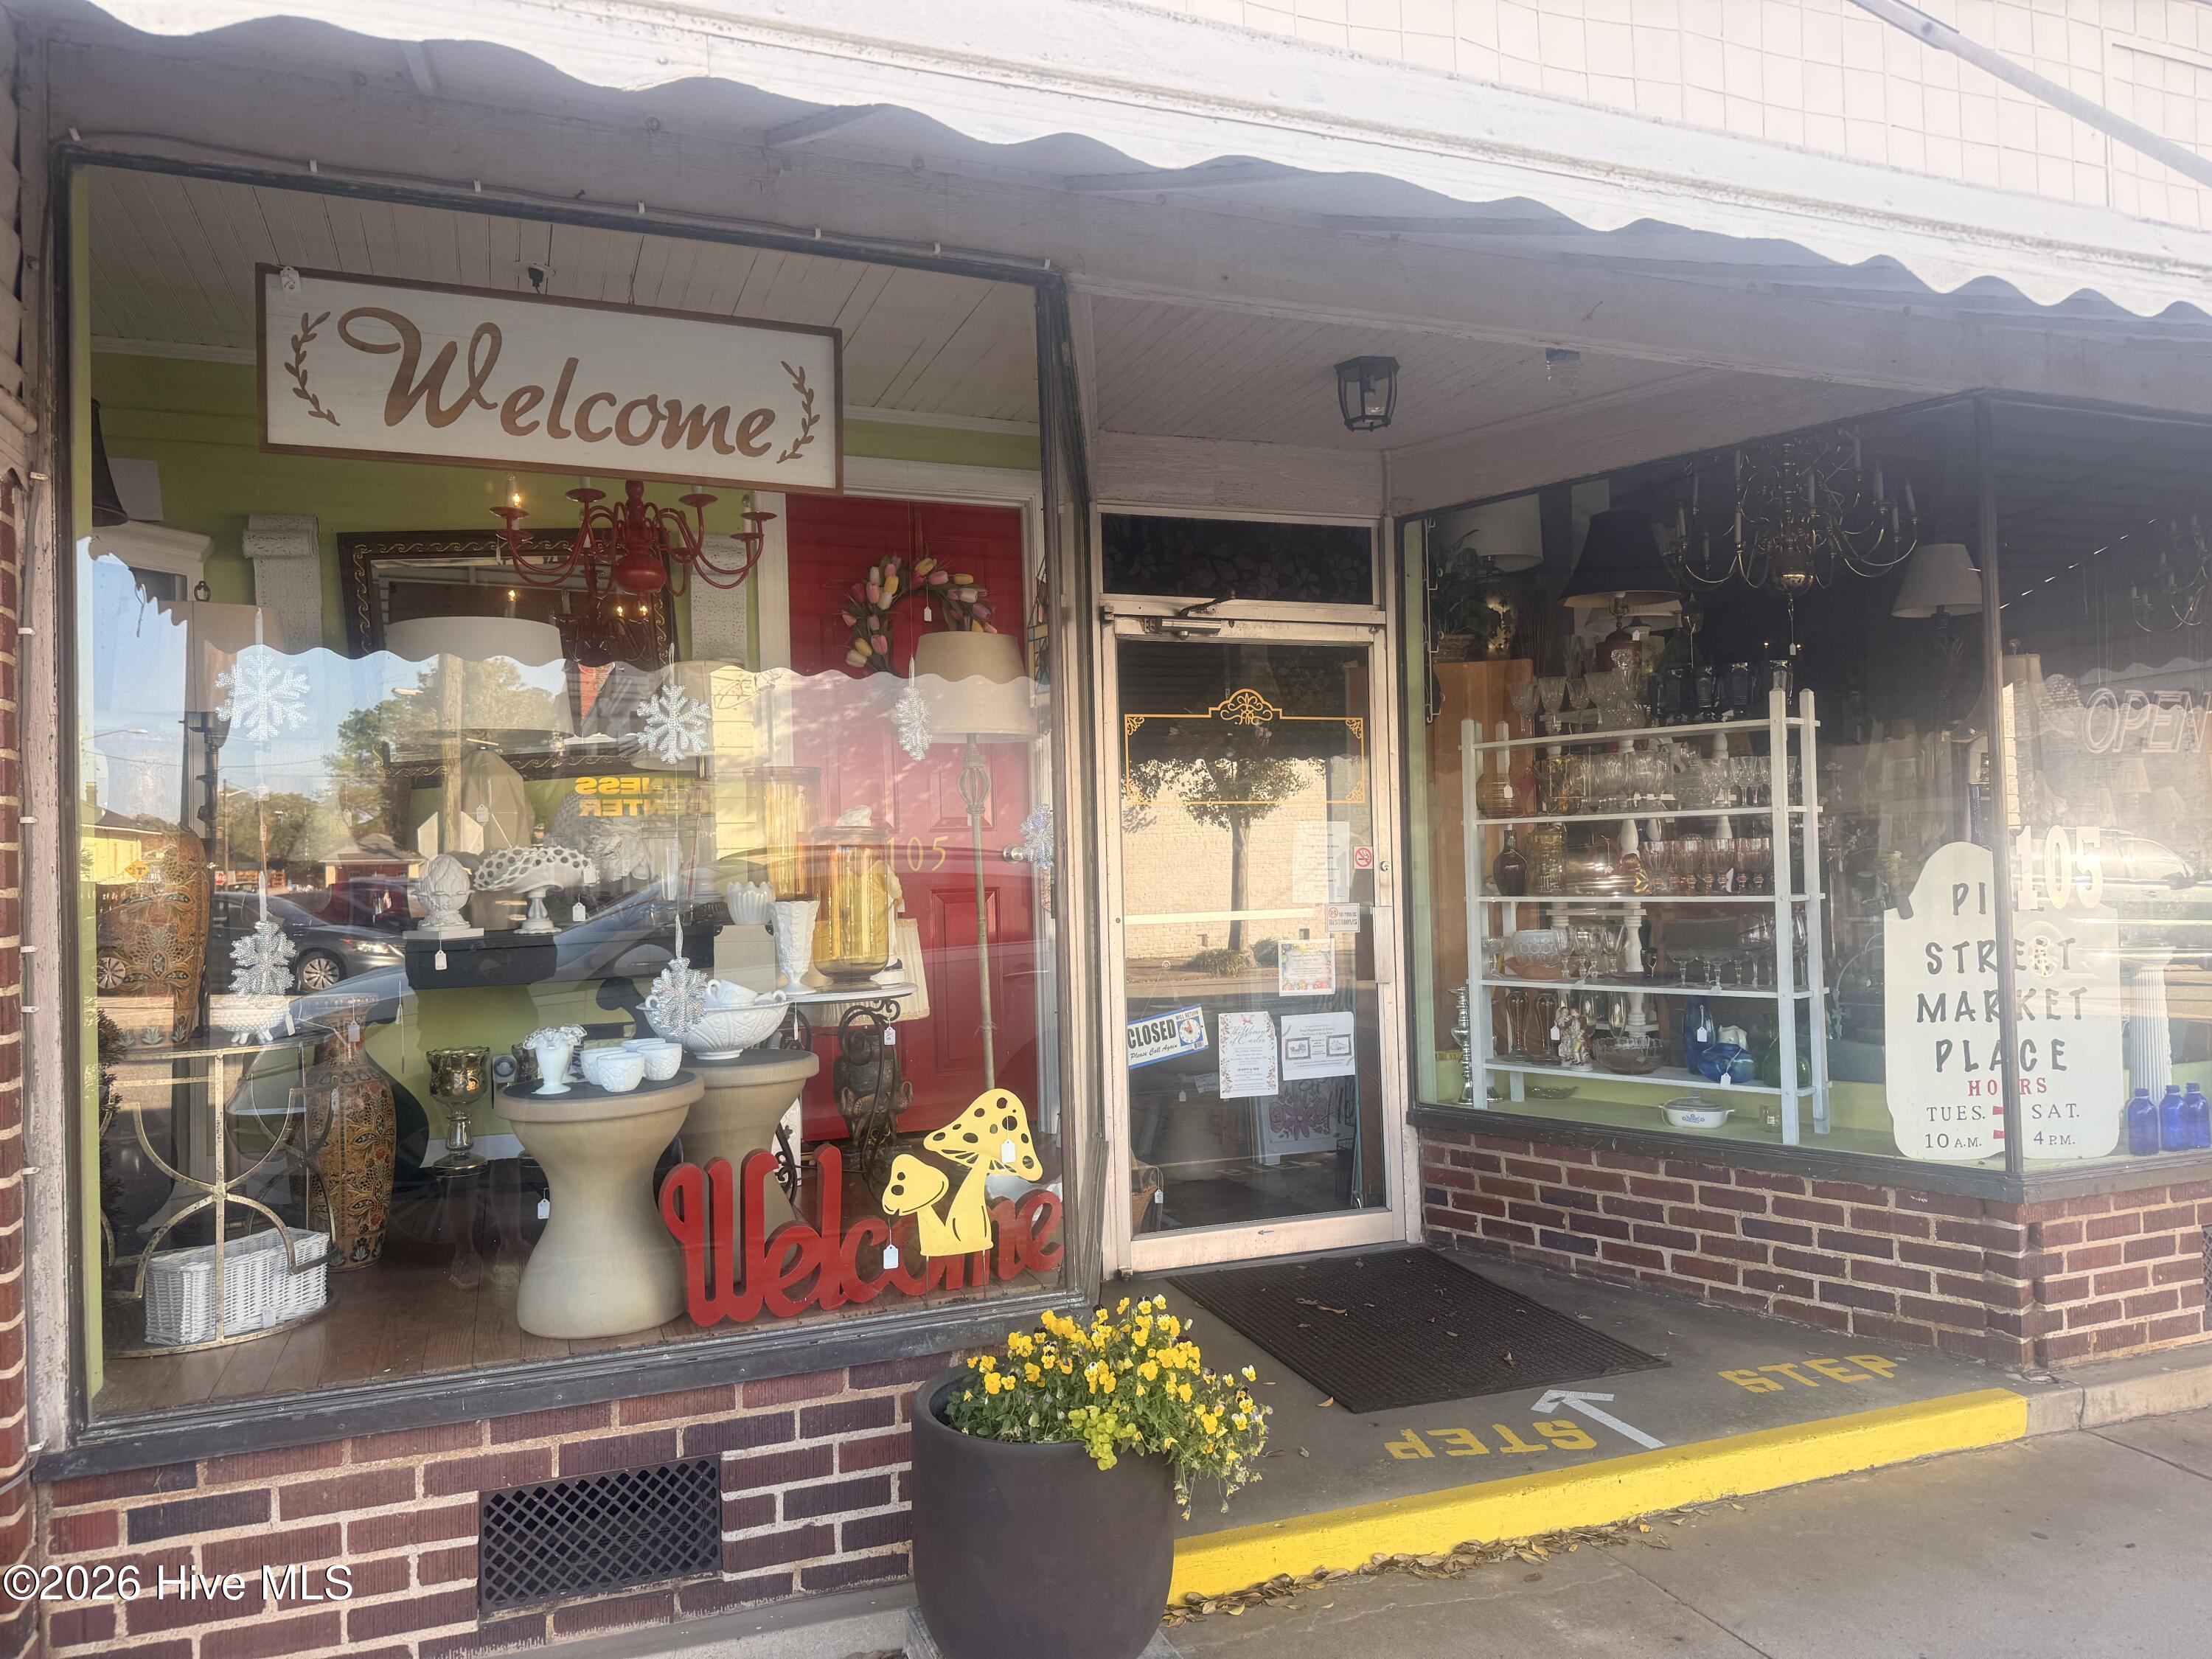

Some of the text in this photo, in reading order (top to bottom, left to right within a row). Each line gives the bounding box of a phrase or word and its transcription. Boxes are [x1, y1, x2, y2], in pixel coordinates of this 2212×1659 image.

[337, 307, 777, 457] Welcome
[2082, 687, 2212, 754] OPEN
[886, 836, 948, 872] 105
[2015, 824, 2102, 909] 105
[1185, 1010, 1199, 1018] RETURN
[1916, 987, 2087, 1023] MARKET
[1127, 1018, 1177, 1049] CLOSED
[1130, 1043, 1178, 1060] Please Call Again
[1967, 1077, 2047, 1096] HORS
[1926, 1103, 2079, 1121] TUES. SAT.
[1924, 1133, 1949, 1148] 10
[2033, 1130, 2044, 1145] 4
[1717, 1354, 1899, 1393] STEP
[1383, 1419, 1597, 1459] STEP
